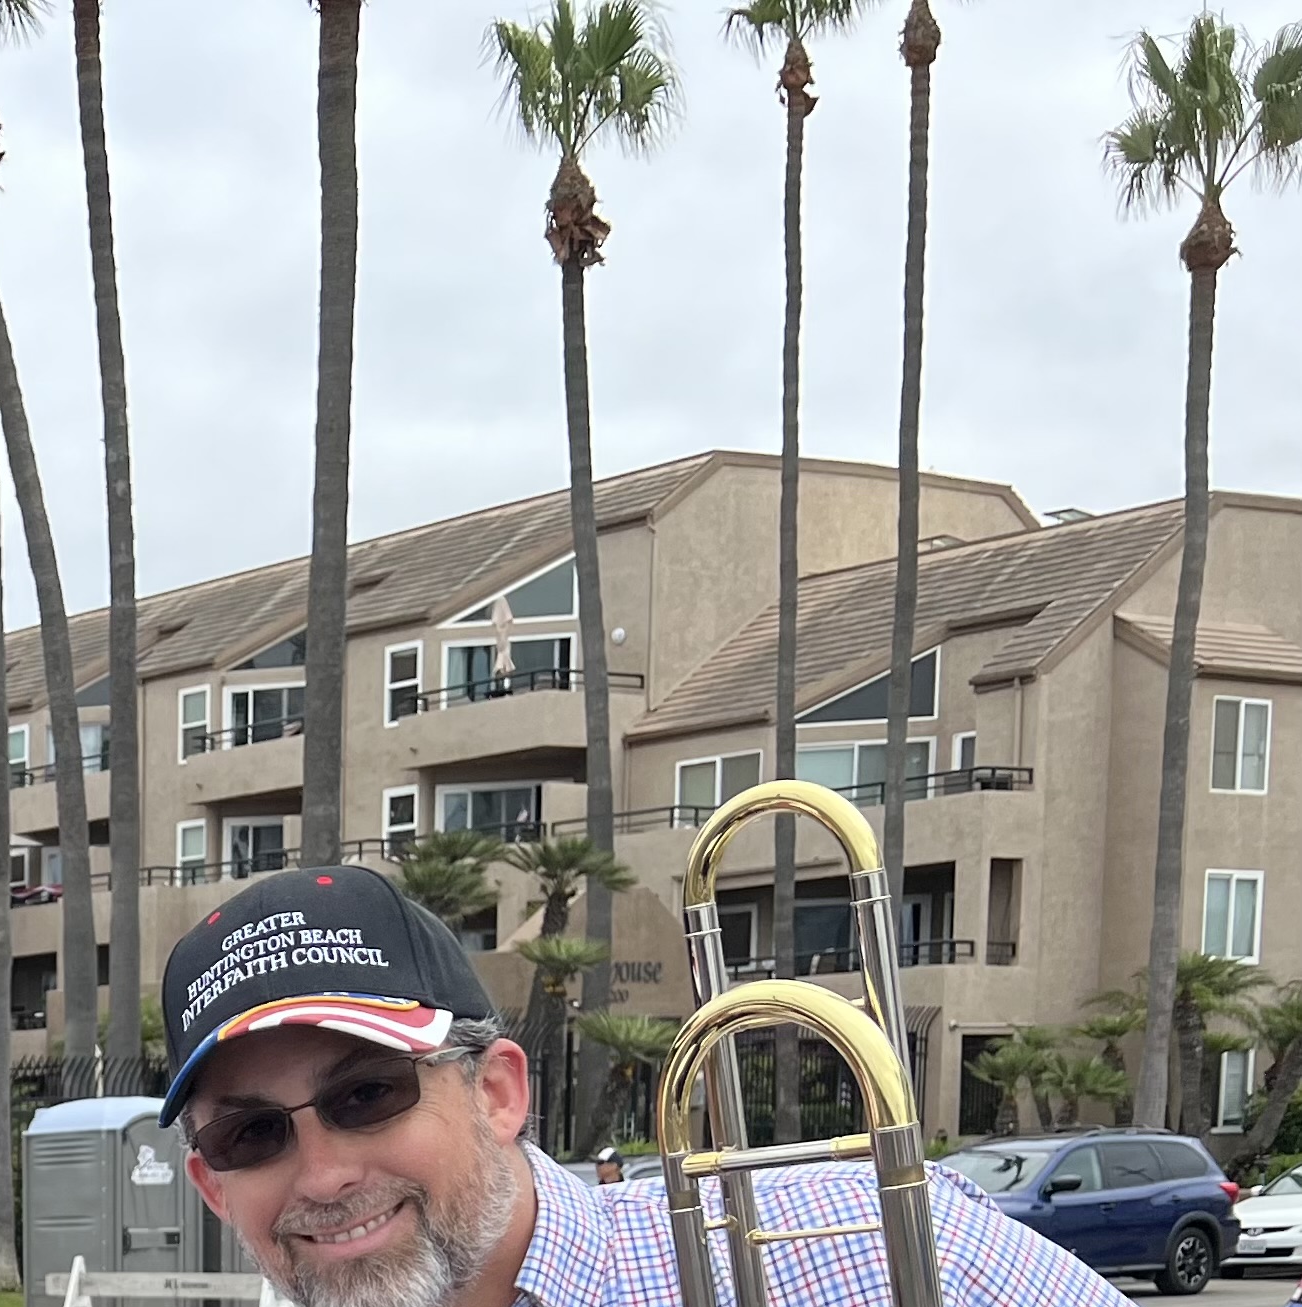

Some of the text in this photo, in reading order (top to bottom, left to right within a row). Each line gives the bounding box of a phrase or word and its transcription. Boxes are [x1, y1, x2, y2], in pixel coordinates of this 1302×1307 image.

[187, 929, 362, 1001] HUNTINGTON BEACH
[221, 911, 306, 952] GREATER
[181, 948, 389, 1031] INTERFAITH COUNCIL
